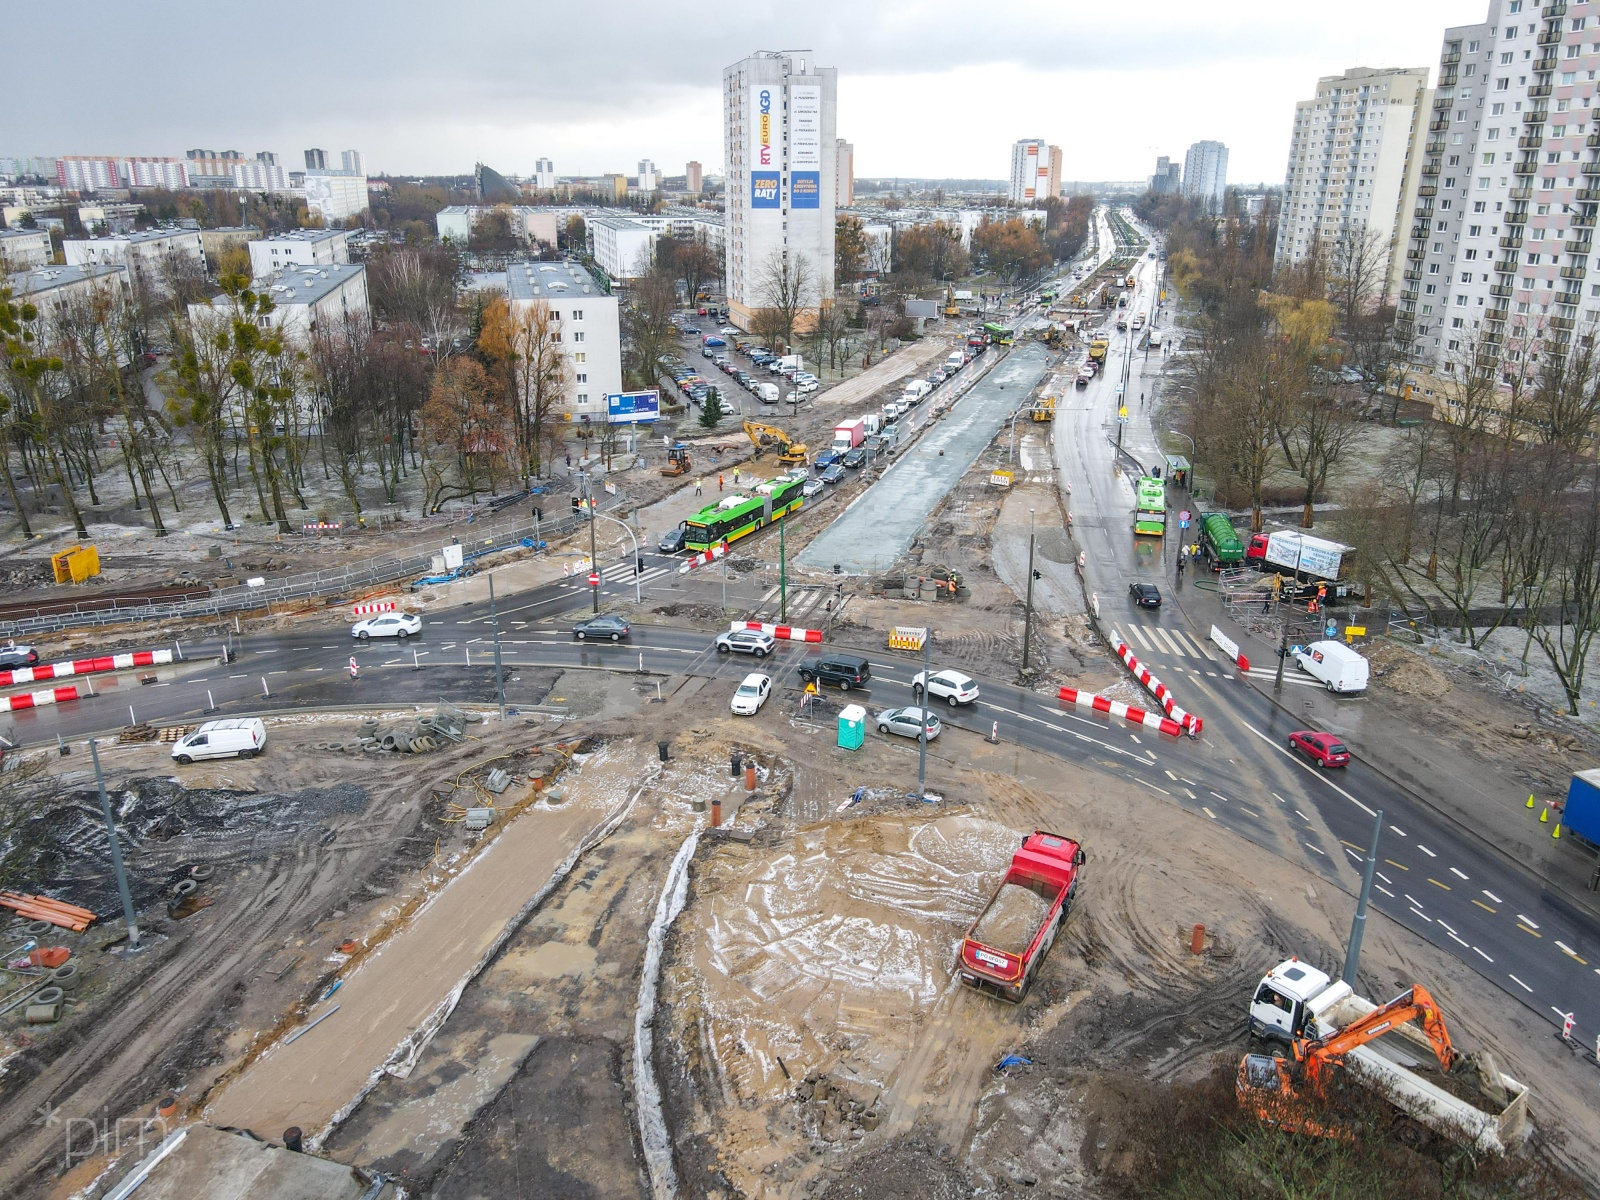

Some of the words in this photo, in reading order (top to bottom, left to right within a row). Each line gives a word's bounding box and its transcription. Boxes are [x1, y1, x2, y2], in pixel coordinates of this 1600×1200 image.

[755, 179, 777, 188] ZERO
[755, 189, 777, 199] RATY
[602, 393, 607, 401] 2
